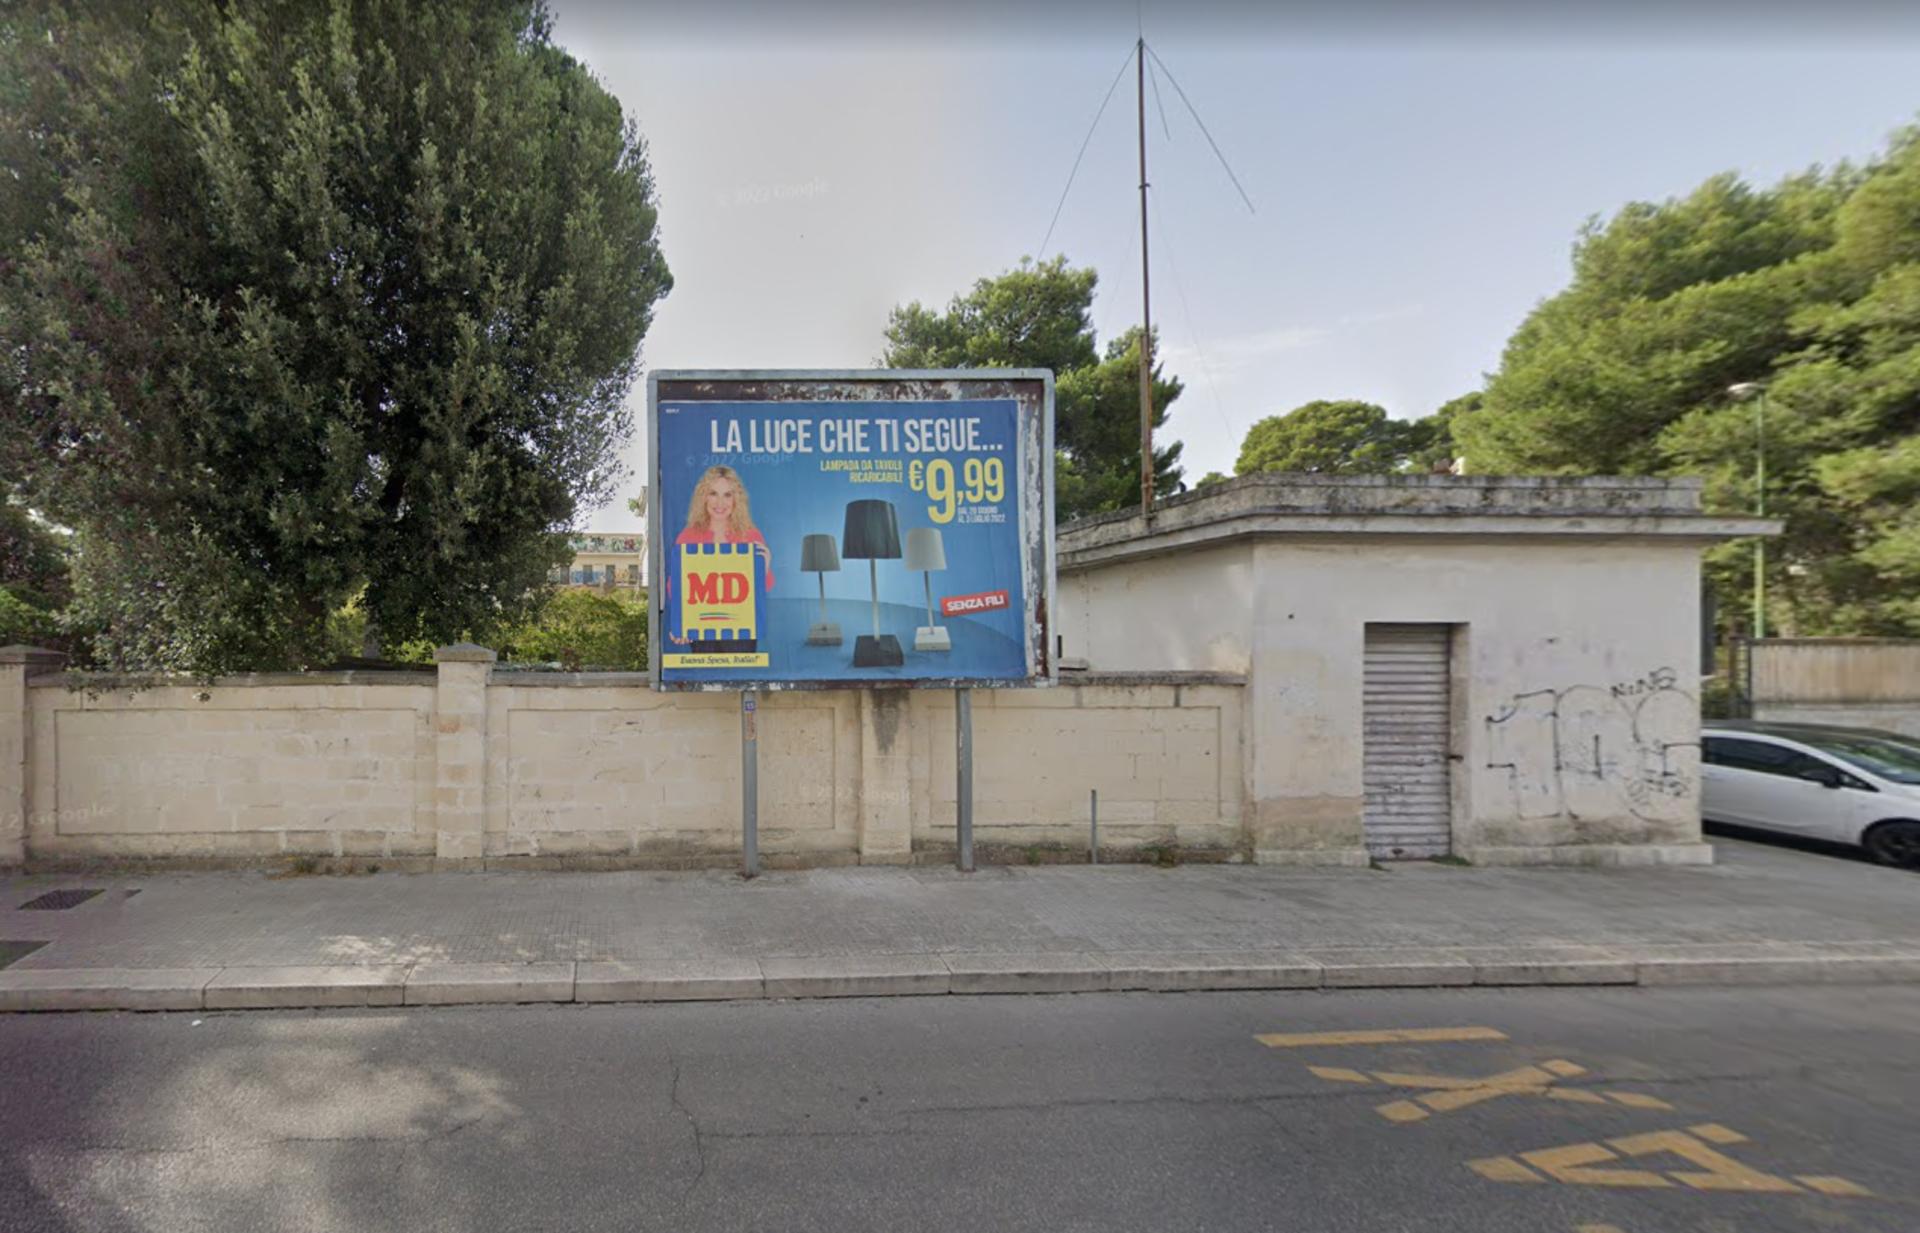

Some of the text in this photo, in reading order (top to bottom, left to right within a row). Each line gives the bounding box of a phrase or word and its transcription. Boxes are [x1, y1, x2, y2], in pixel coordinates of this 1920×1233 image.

[711, 417, 1003, 454] LA LUCE CHE TI SEGUE...
[687, 572, 749, 605] MD
[946, 594, 1005, 612] SENZA FILI
